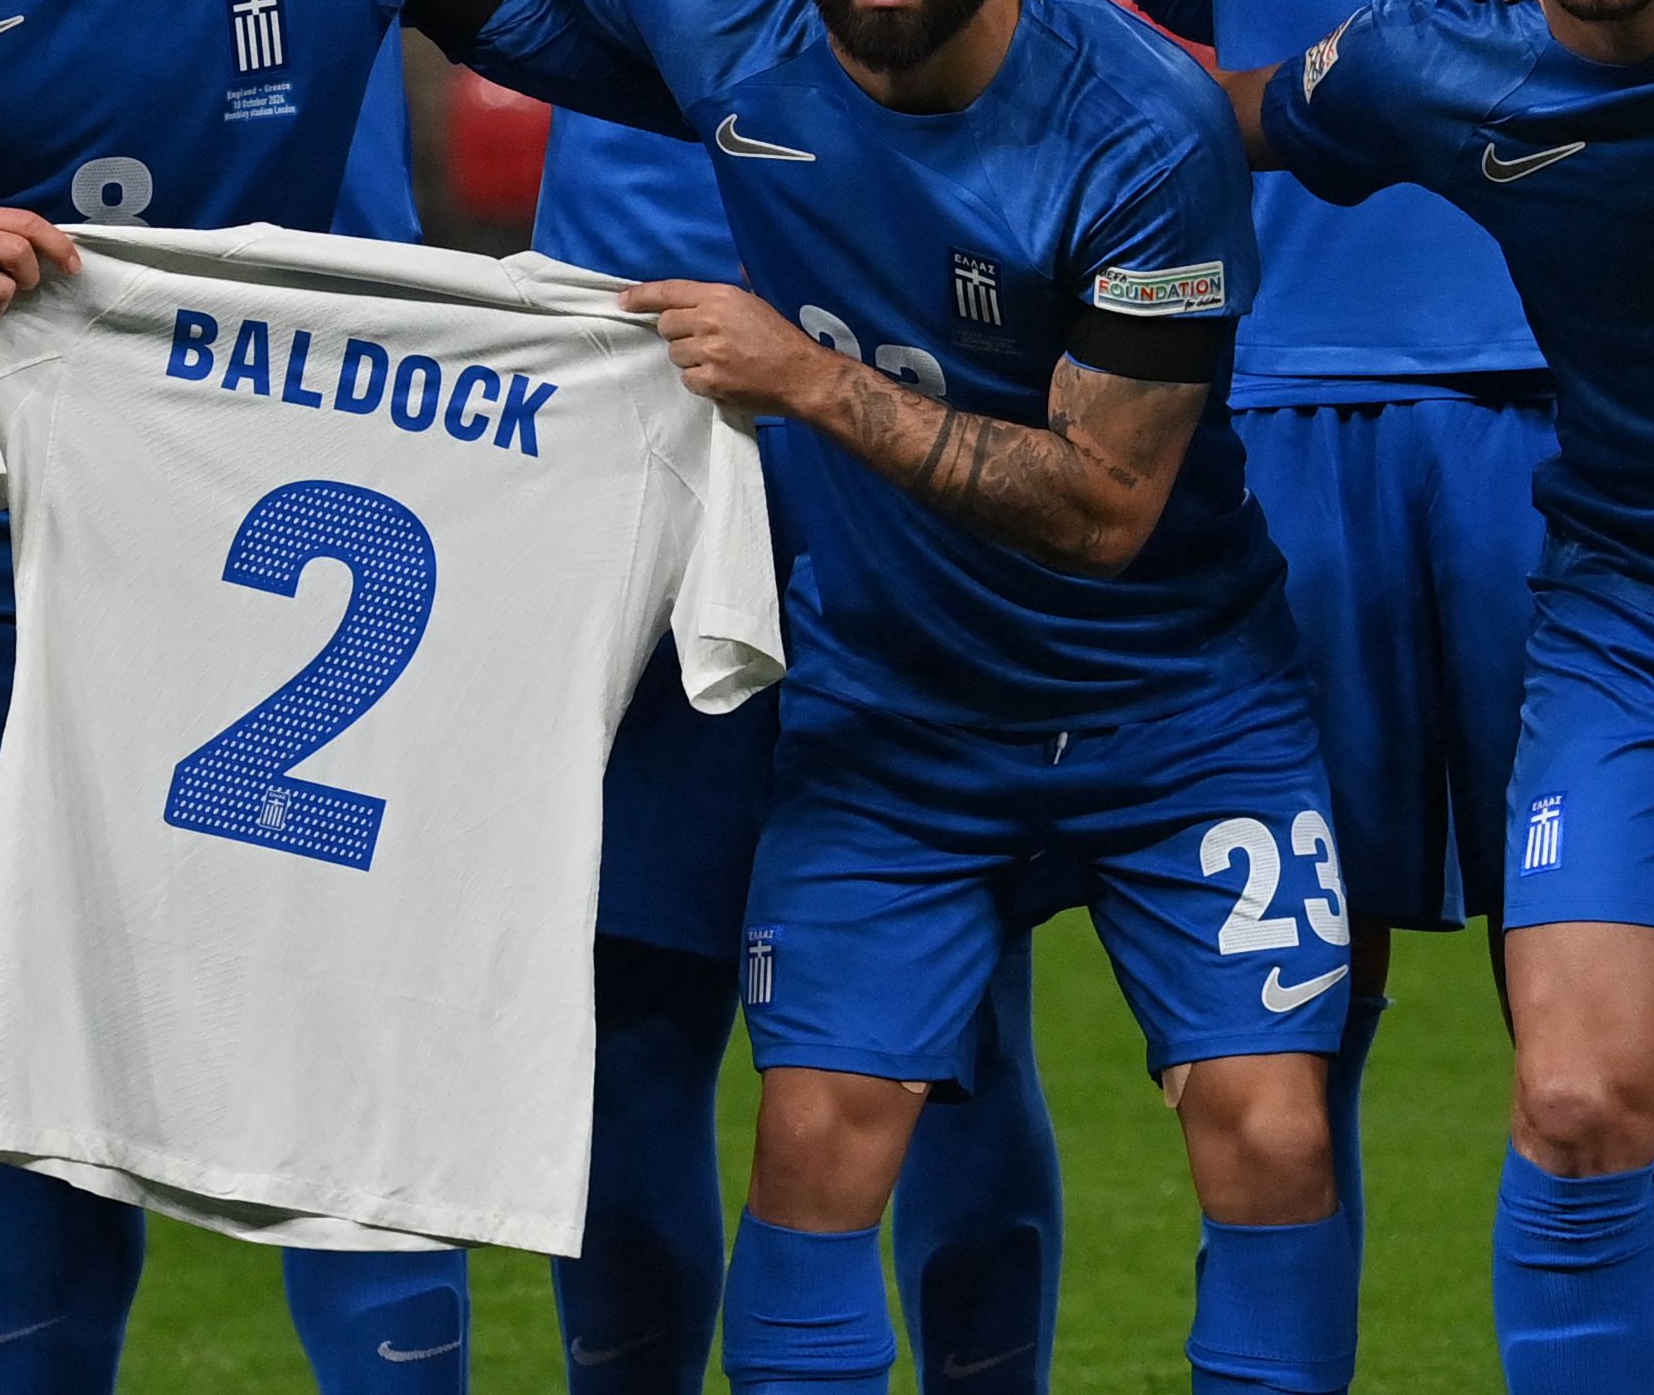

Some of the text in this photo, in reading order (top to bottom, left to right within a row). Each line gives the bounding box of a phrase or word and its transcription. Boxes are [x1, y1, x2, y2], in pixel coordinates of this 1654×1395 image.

[71, 156, 153, 227] 8
[954, 253, 995, 275] ΕΛΛΑΣ
[1099, 275, 1222, 302] FOUNDATION
[165, 308, 559, 458] BALDOCK
[163, 479, 437, 872] 2
[1200, 810, 1350, 955] 23
